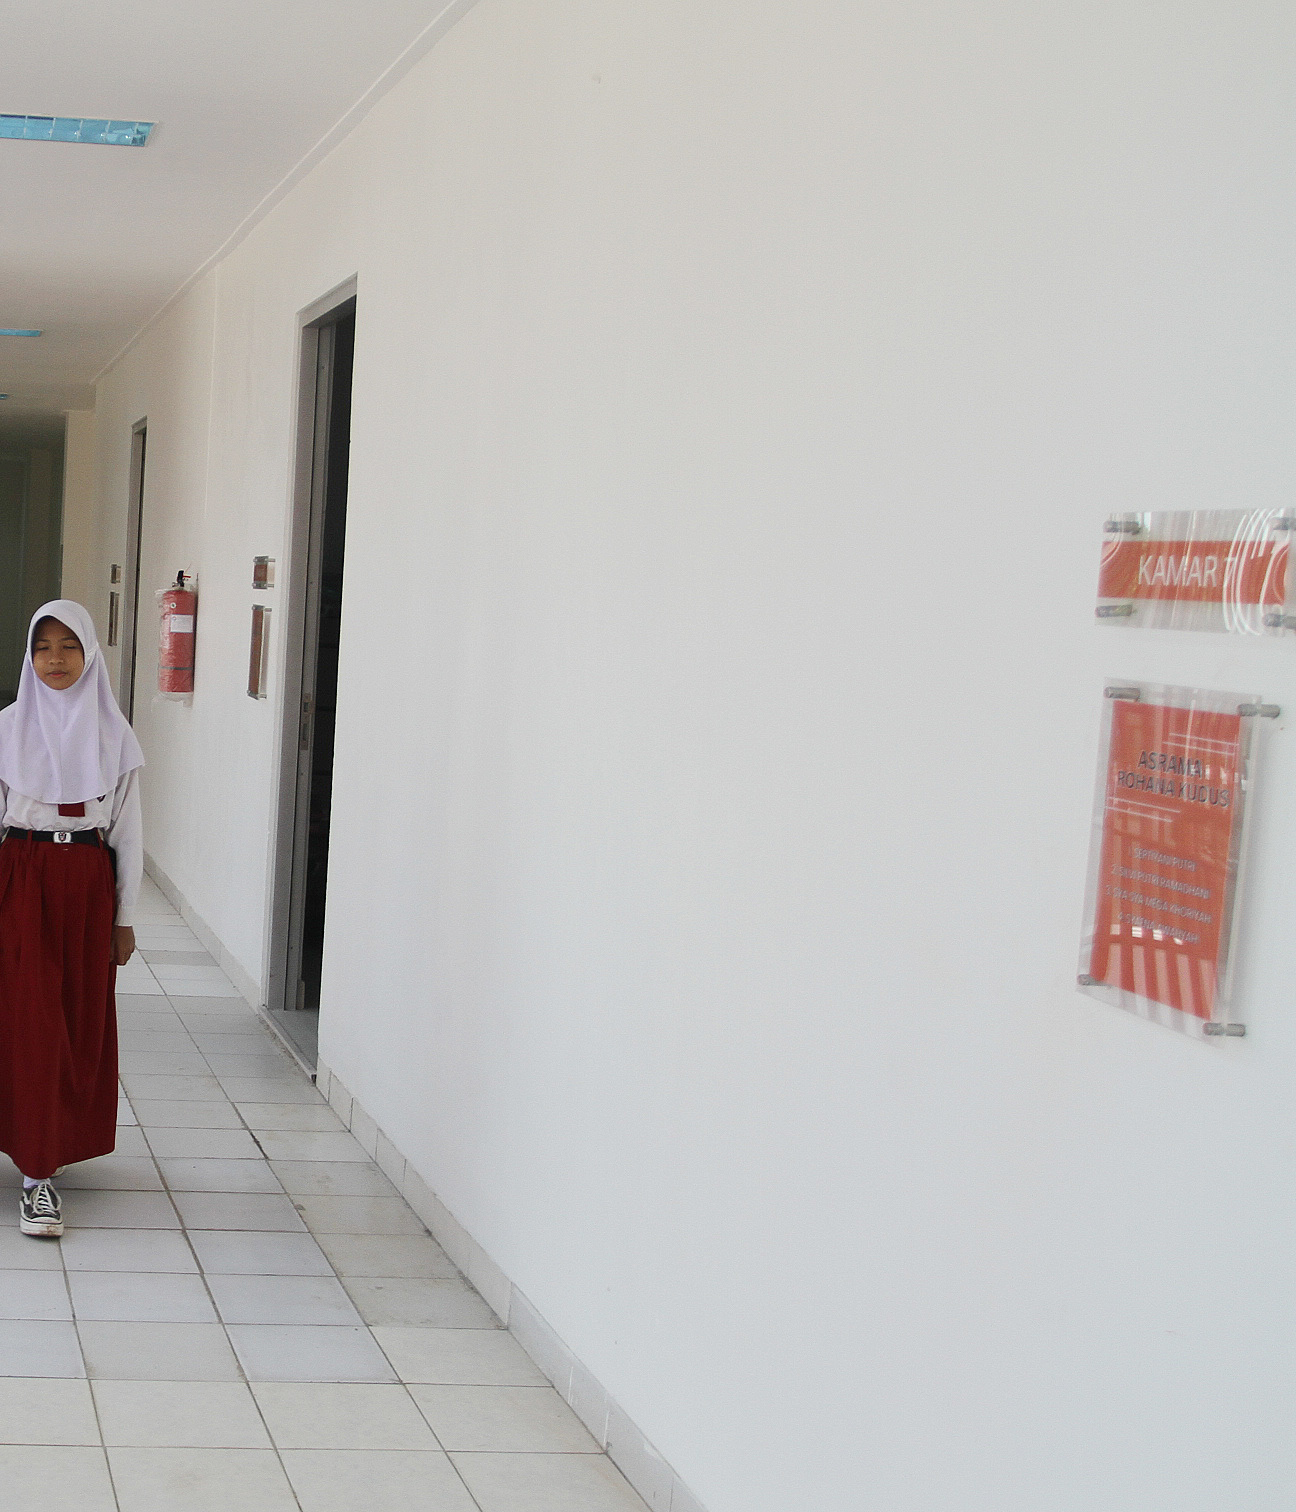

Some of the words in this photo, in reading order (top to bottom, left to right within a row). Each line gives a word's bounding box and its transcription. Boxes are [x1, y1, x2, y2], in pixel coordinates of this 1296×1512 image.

[1138, 555, 1218, 587] KAMAR
[1138, 751, 1202, 778] ASRAMA
[1117, 771, 1175, 798] ROHANA
[1178, 782, 1231, 808] KUDUS
